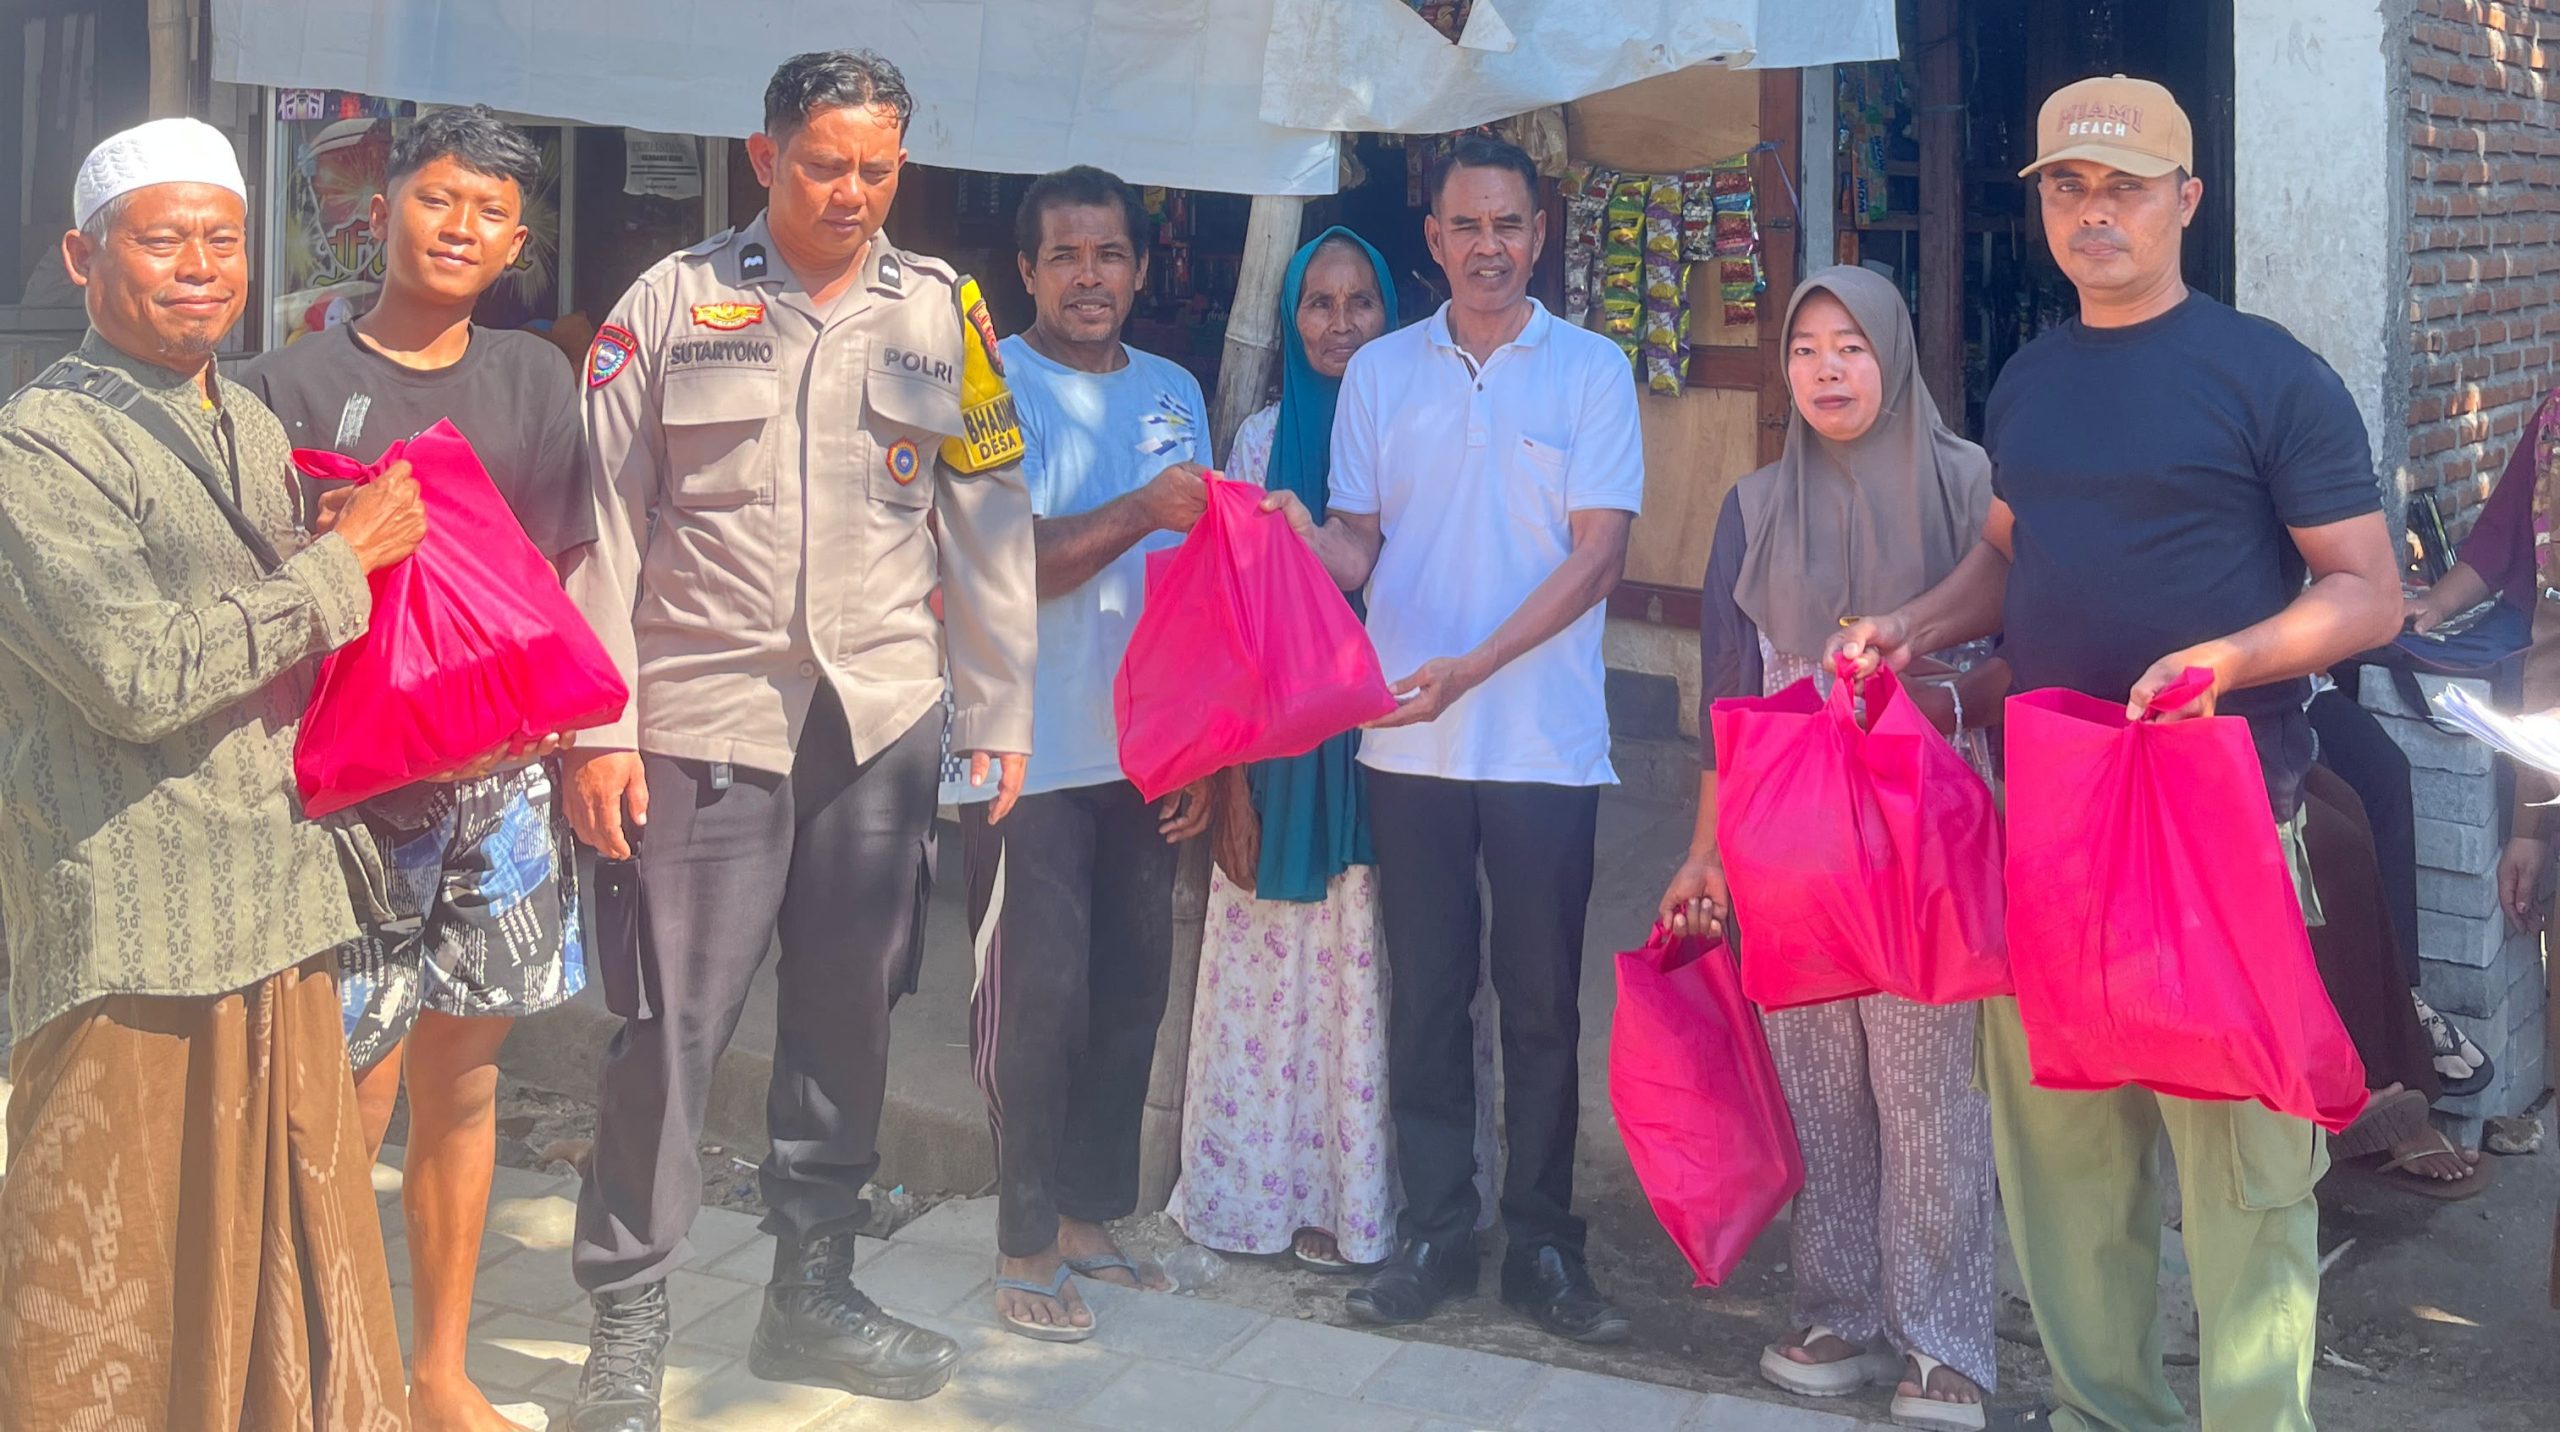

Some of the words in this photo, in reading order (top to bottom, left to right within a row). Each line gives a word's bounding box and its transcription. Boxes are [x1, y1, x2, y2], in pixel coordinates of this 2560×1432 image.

[2057, 103, 2143, 133] MIAMI
[2068, 121, 2126, 136] BEACH
[670, 340, 773, 364] SUTARYONO
[884, 347, 952, 384] POLRI
[978, 432, 1017, 460] DESA
